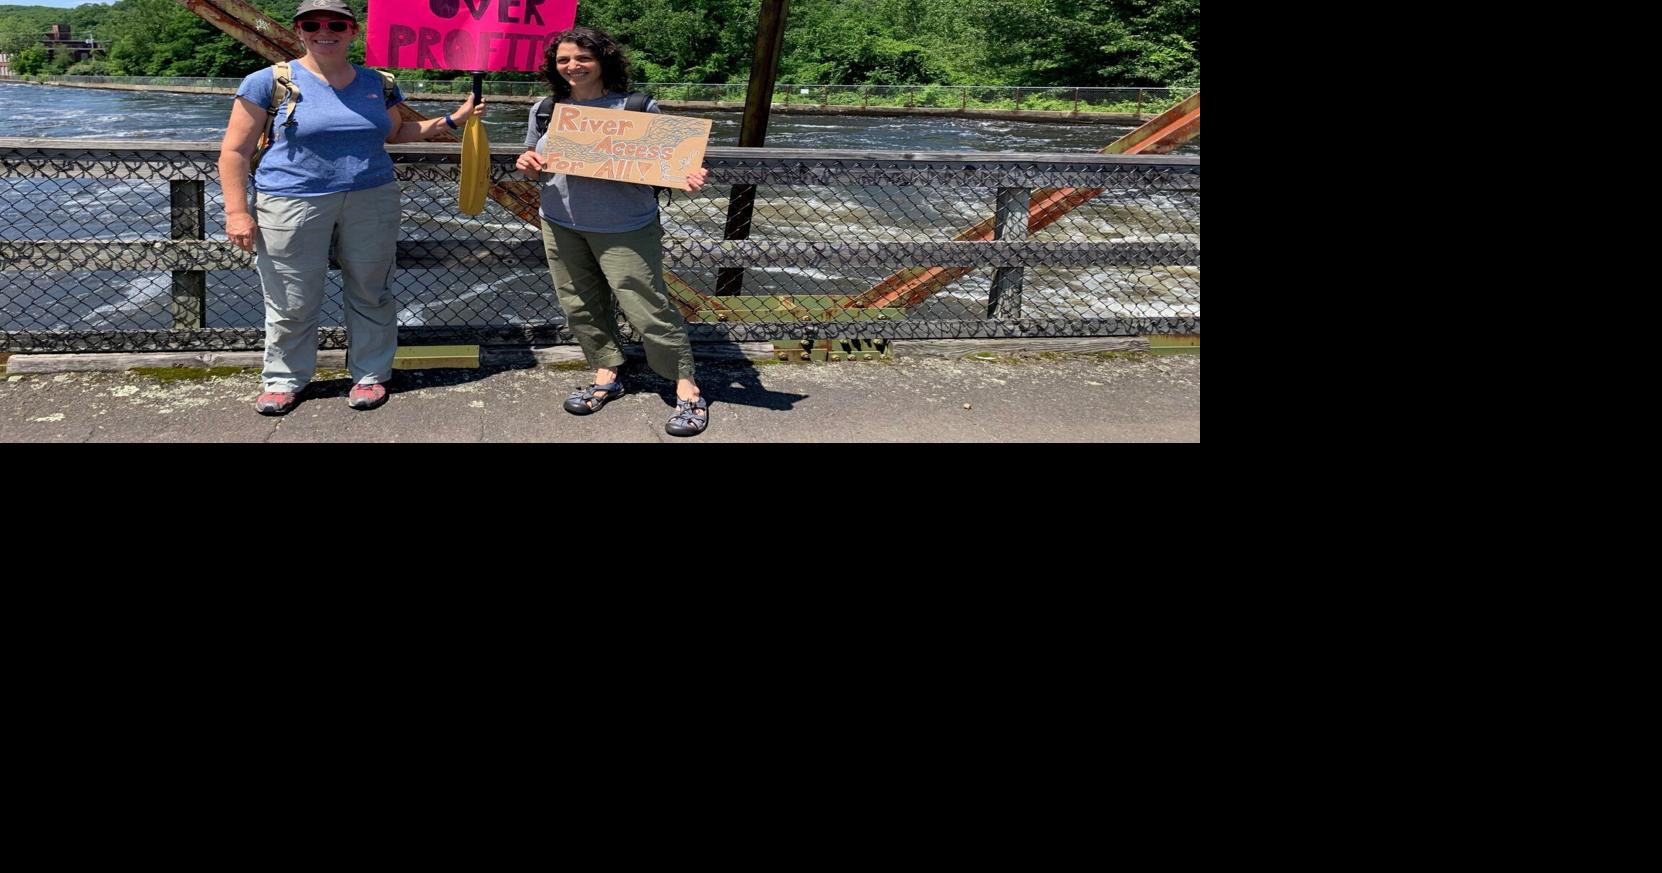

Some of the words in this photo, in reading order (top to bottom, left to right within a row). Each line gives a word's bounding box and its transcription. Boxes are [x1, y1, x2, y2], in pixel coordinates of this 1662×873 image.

[428, 0, 546, 26] OVER
[558, 107, 634, 136] River
[591, 136, 674, 161] Access
[546, 152, 584, 173] For
